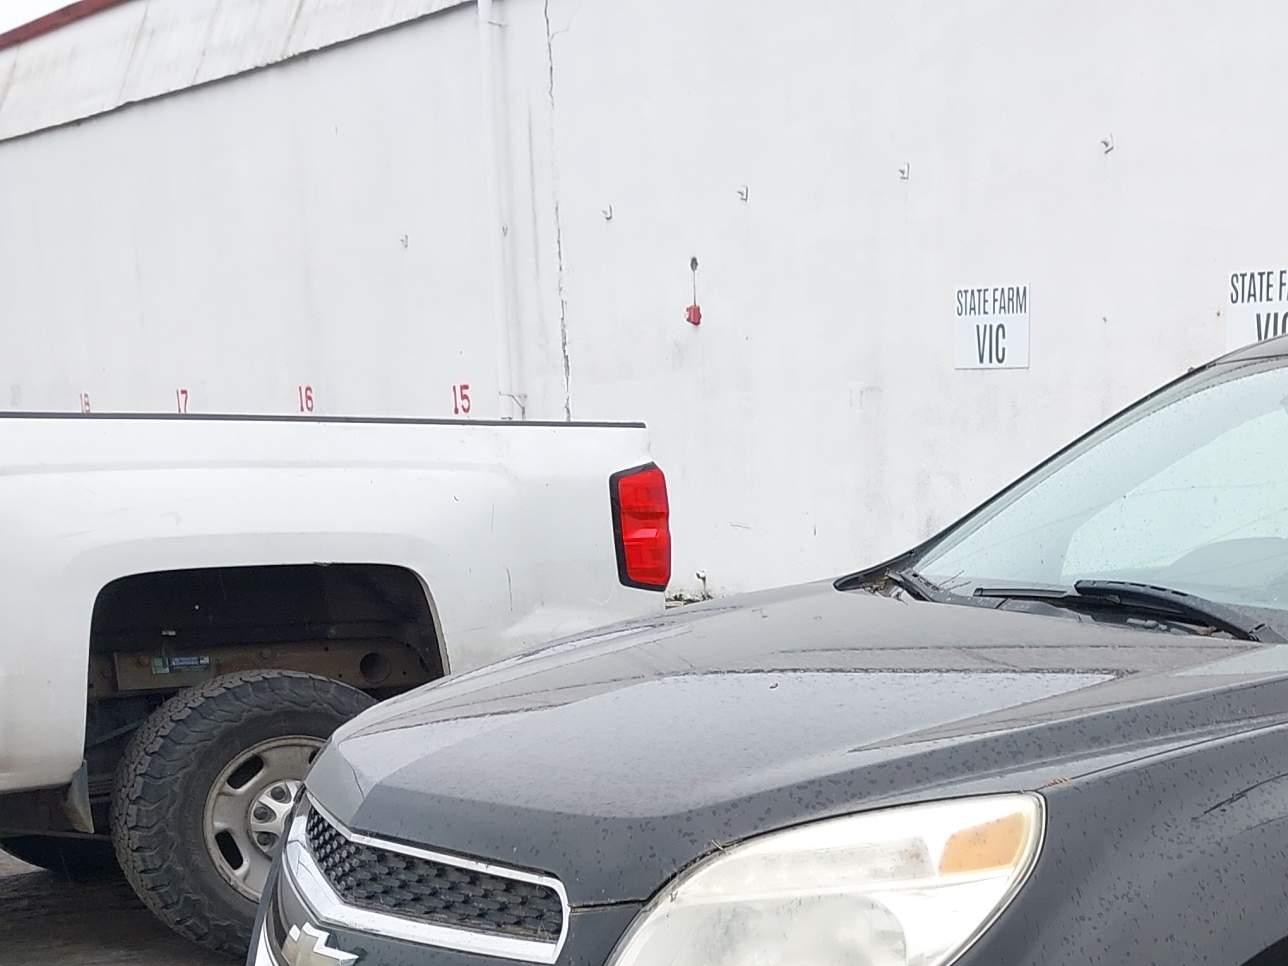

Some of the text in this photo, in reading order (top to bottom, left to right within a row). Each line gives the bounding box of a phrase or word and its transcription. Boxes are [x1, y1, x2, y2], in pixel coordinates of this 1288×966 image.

[956, 285, 1027, 317] STATE FARM
[1230, 270, 1274, 304] STATE
[975, 323, 1006, 364] VIC
[176, 388, 189, 413] 17
[298, 385, 315, 412] 16
[452, 384, 471, 415] 15
